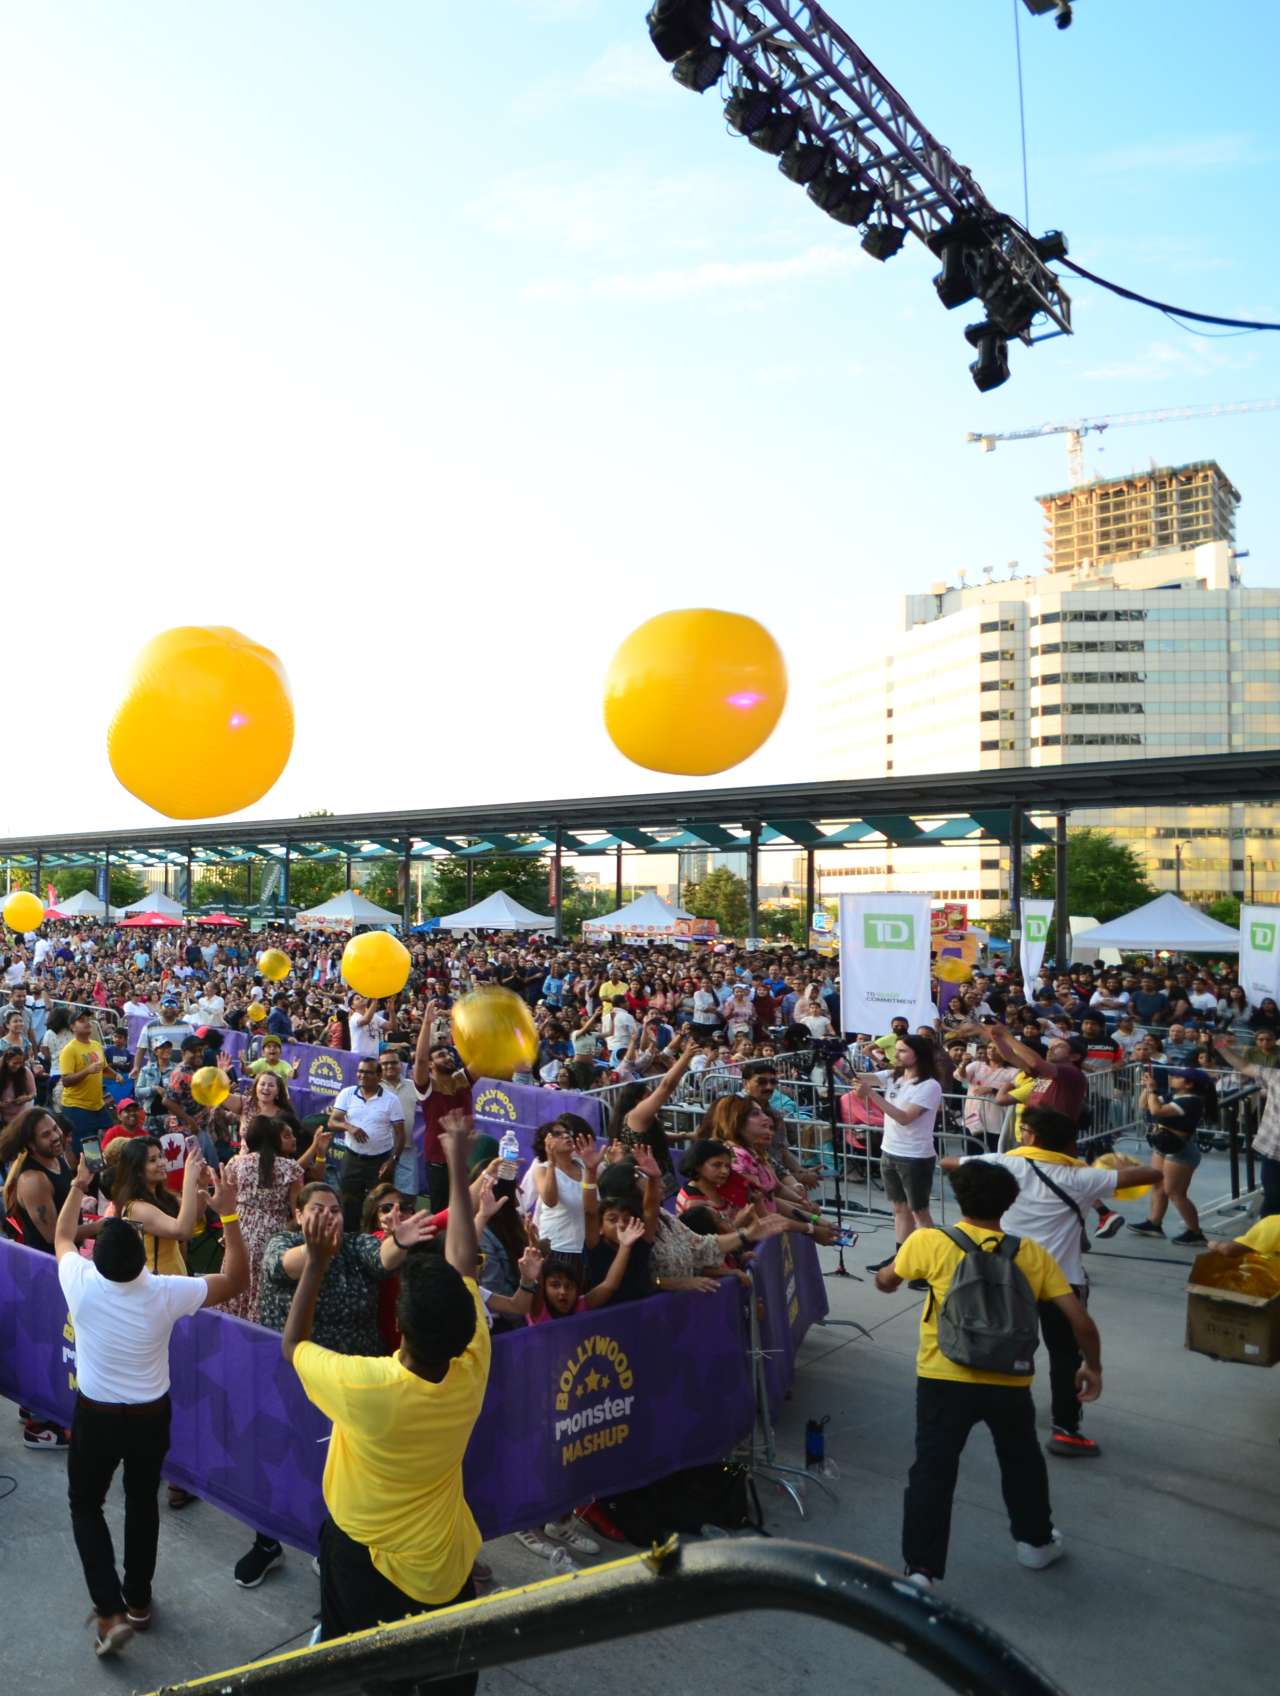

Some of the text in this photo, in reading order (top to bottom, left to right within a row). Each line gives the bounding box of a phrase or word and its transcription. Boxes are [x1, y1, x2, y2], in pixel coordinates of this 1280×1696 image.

[868, 919, 909, 944] TD
[1027, 919, 1047, 937] TD
[1252, 927, 1272, 945] TD
[309, 1055, 343, 1081] BOLLYWOOD
[475, 1088, 517, 1120] BOLLYWOOD
[555, 1335, 634, 1411] BOLLYWOOD
[555, 1395, 635, 1441] monster
[562, 1424, 630, 1467] MASHUP
